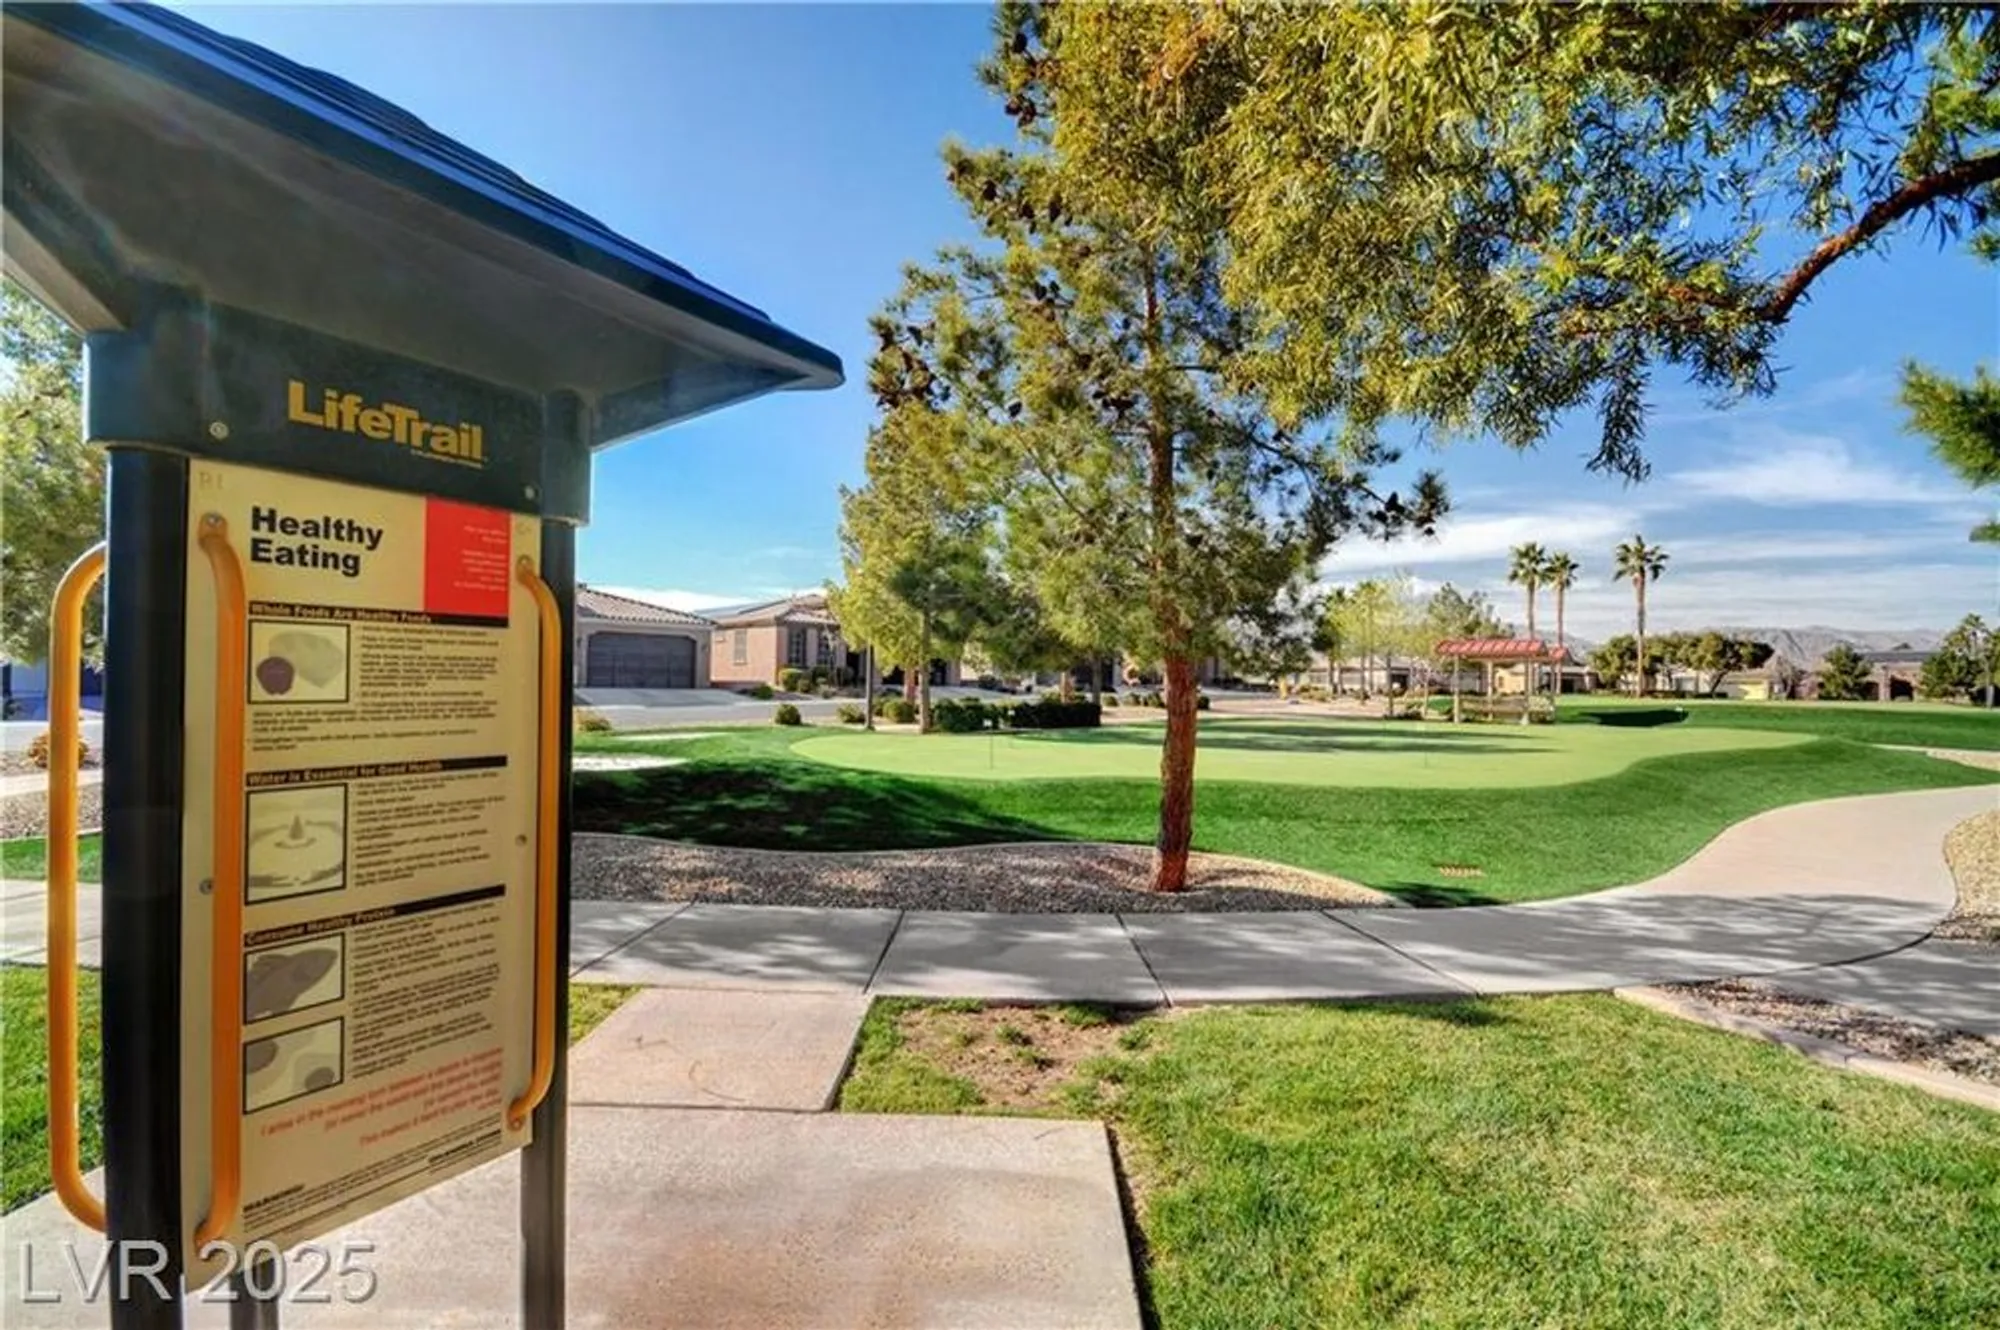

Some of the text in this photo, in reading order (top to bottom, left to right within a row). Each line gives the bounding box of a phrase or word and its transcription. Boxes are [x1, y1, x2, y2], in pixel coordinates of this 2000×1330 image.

[288, 379, 483, 460] LifeTrail
[251, 505, 383, 551] Healthy
[250, 537, 361, 578] Eating
